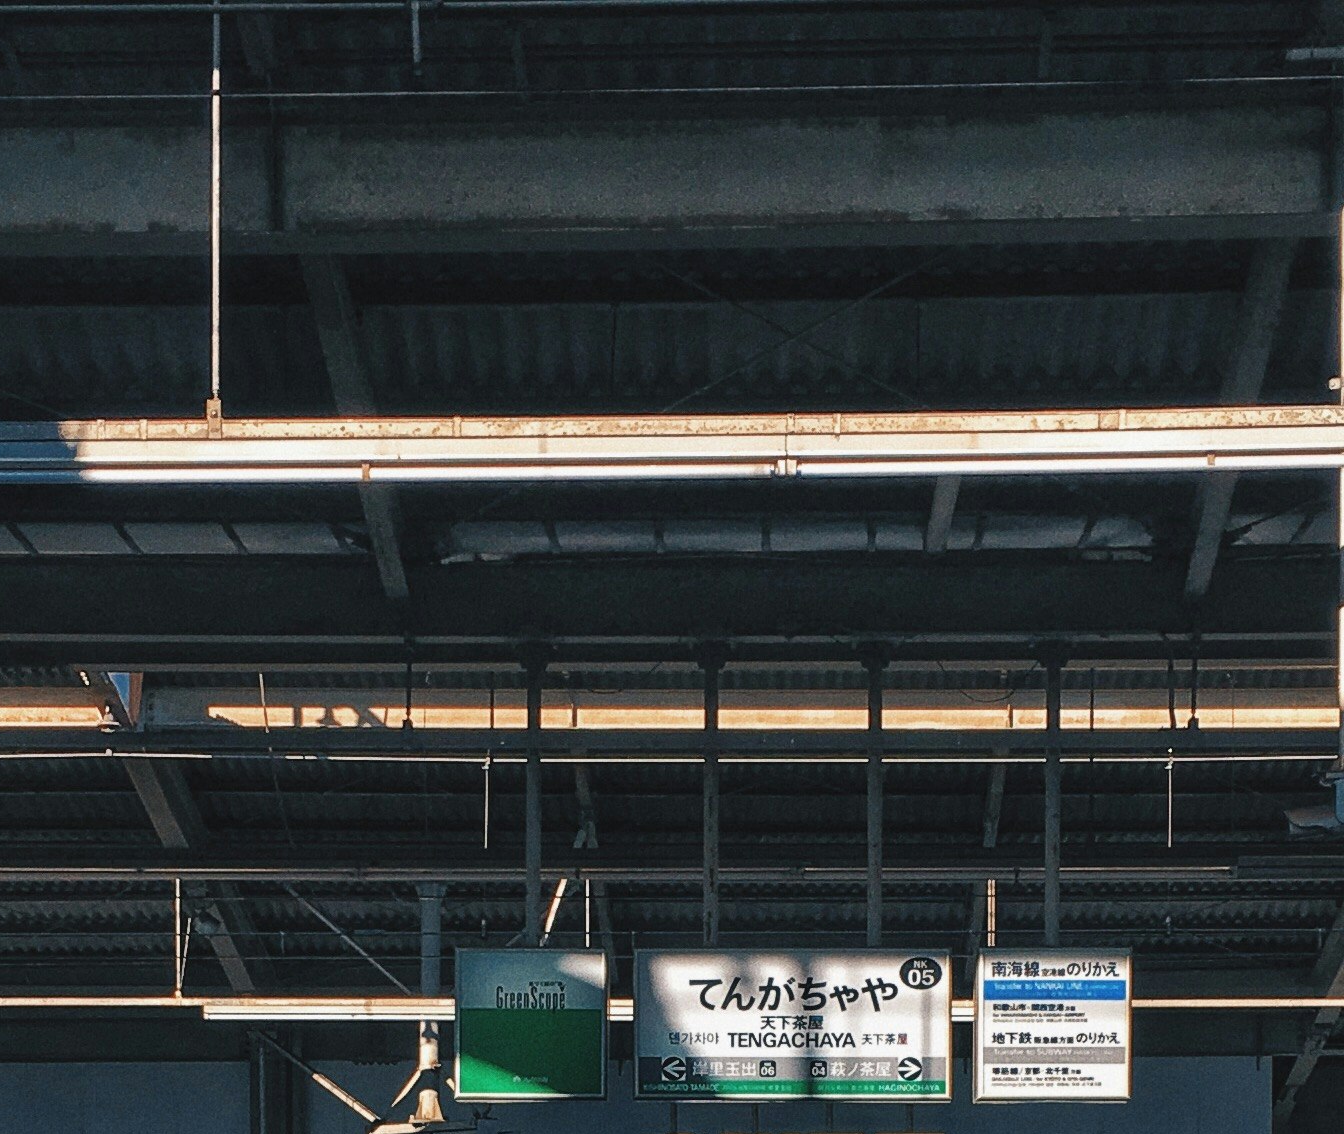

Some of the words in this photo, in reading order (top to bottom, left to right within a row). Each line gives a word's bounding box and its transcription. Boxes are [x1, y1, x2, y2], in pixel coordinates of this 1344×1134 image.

[913, 960, 928, 969] NK
[907, 968, 936, 986] 05
[496, 986, 566, 1011] GreenScope
[689, 976, 899, 1012] てんがちゃや
[760, 1015, 824, 1031] 天下茶屋
[727, 1032, 856, 1048] TENGACHAYA
[861, 1032, 908, 1046] 天下茶屋
[691, 1060, 757, 1078] 岸里玉出
[760, 1066, 776, 1077] 06
[811, 1066, 826, 1077] 04
[829, 1060, 892, 1078] 萩ノ茶屋
[877, 1083, 941, 1093] HAGINOCHAYA
